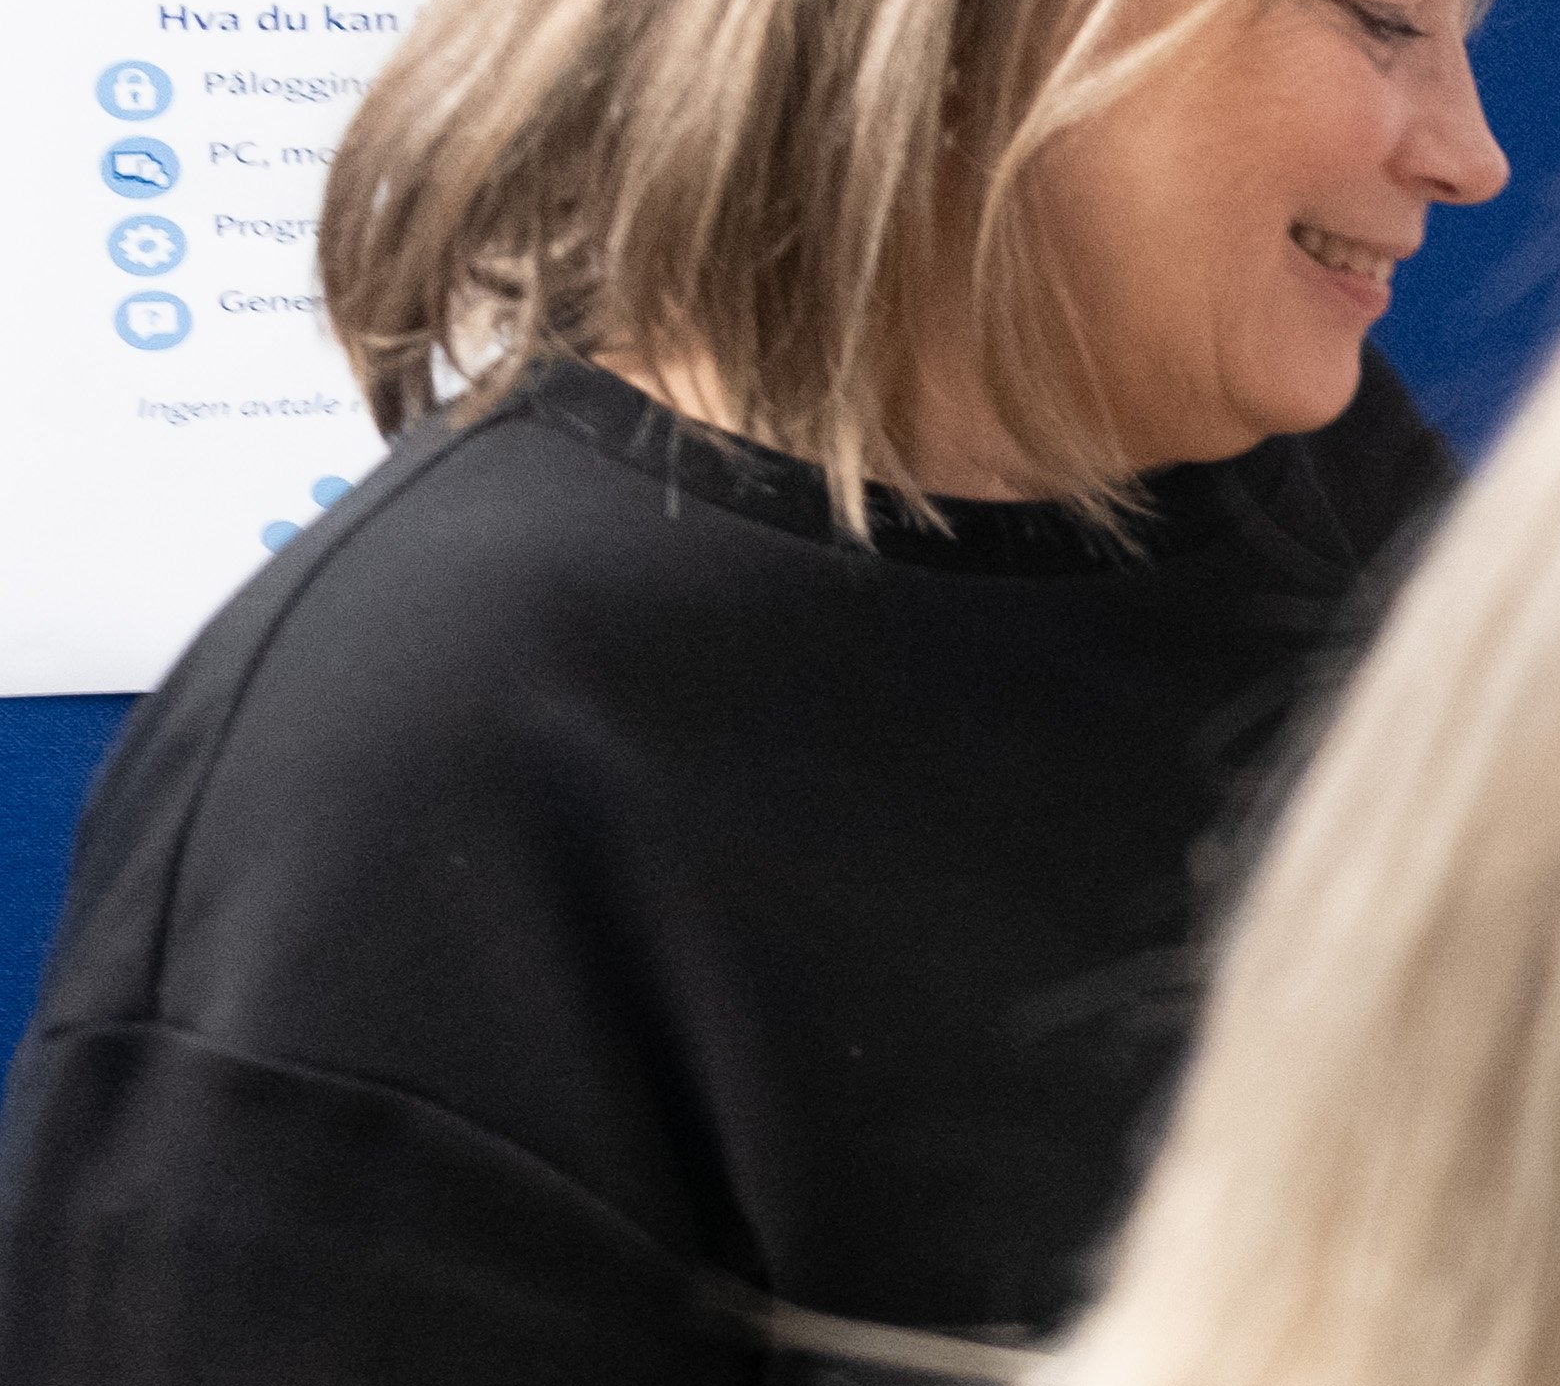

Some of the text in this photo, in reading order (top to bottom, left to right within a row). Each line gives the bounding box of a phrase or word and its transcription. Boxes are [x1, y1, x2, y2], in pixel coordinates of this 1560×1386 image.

[158, 3, 400, 32] Hva du kan
[208, 140, 336, 168] PC, mo
[214, 213, 319, 245] Progr
[136, 397, 230, 427] Ingen
